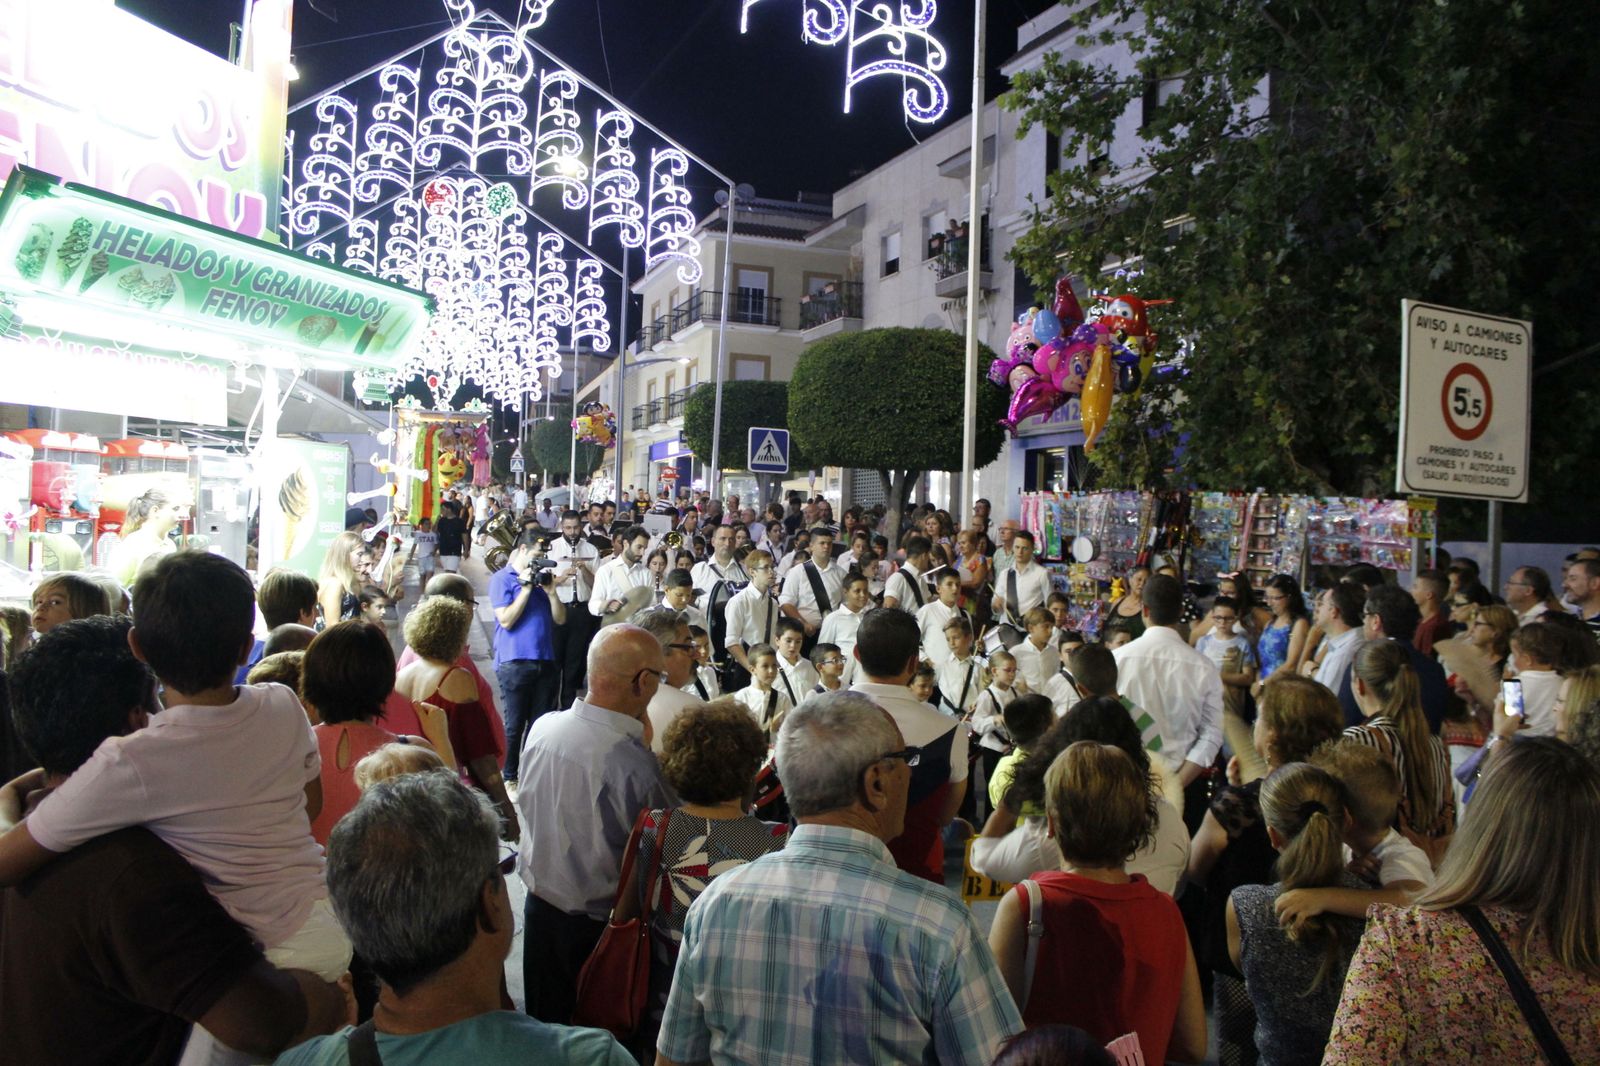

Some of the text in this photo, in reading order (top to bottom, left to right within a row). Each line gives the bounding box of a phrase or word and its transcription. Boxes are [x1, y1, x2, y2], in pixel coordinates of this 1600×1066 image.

[92, 220, 389, 322] HELADOS Y GRANIZADOS
[200, 287, 288, 329] FENOY
[1416, 316, 1523, 345] AVISO A CAMIONES
[1431, 337, 1508, 361] Y AUTOCARES
[1416, 456, 1456, 469] CAMIONES
[1469, 462, 1516, 475] AUTOCARES
[1429, 445, 1503, 461] PROHIBIDO PASO A
